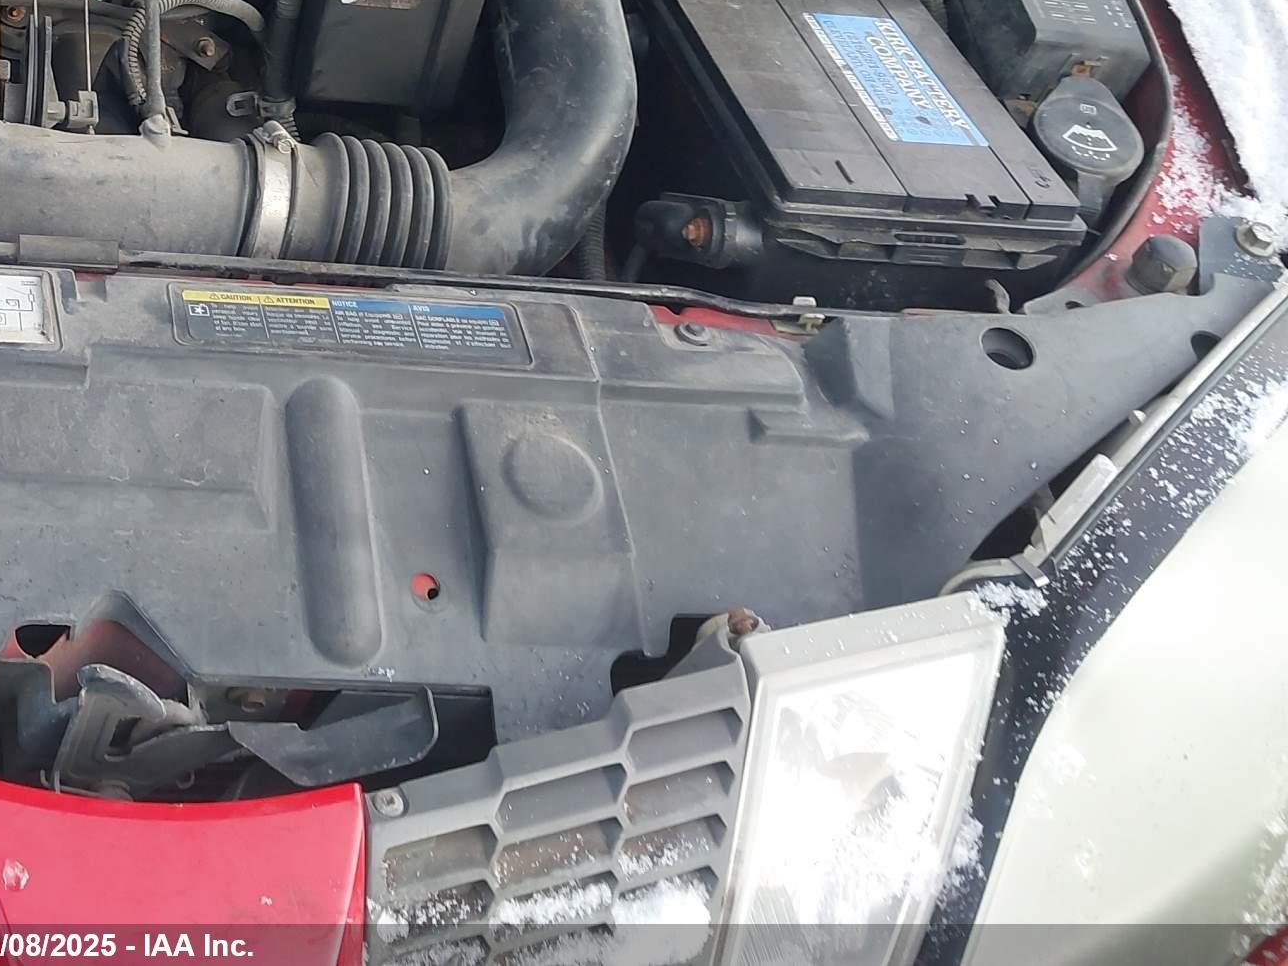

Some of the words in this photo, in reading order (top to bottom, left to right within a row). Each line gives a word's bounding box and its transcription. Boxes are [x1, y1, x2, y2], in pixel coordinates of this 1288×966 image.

[863, 36, 933, 108] COMPANY
[873, 22, 914, 55] KIRK
[901, 59, 970, 128] BATTERY
